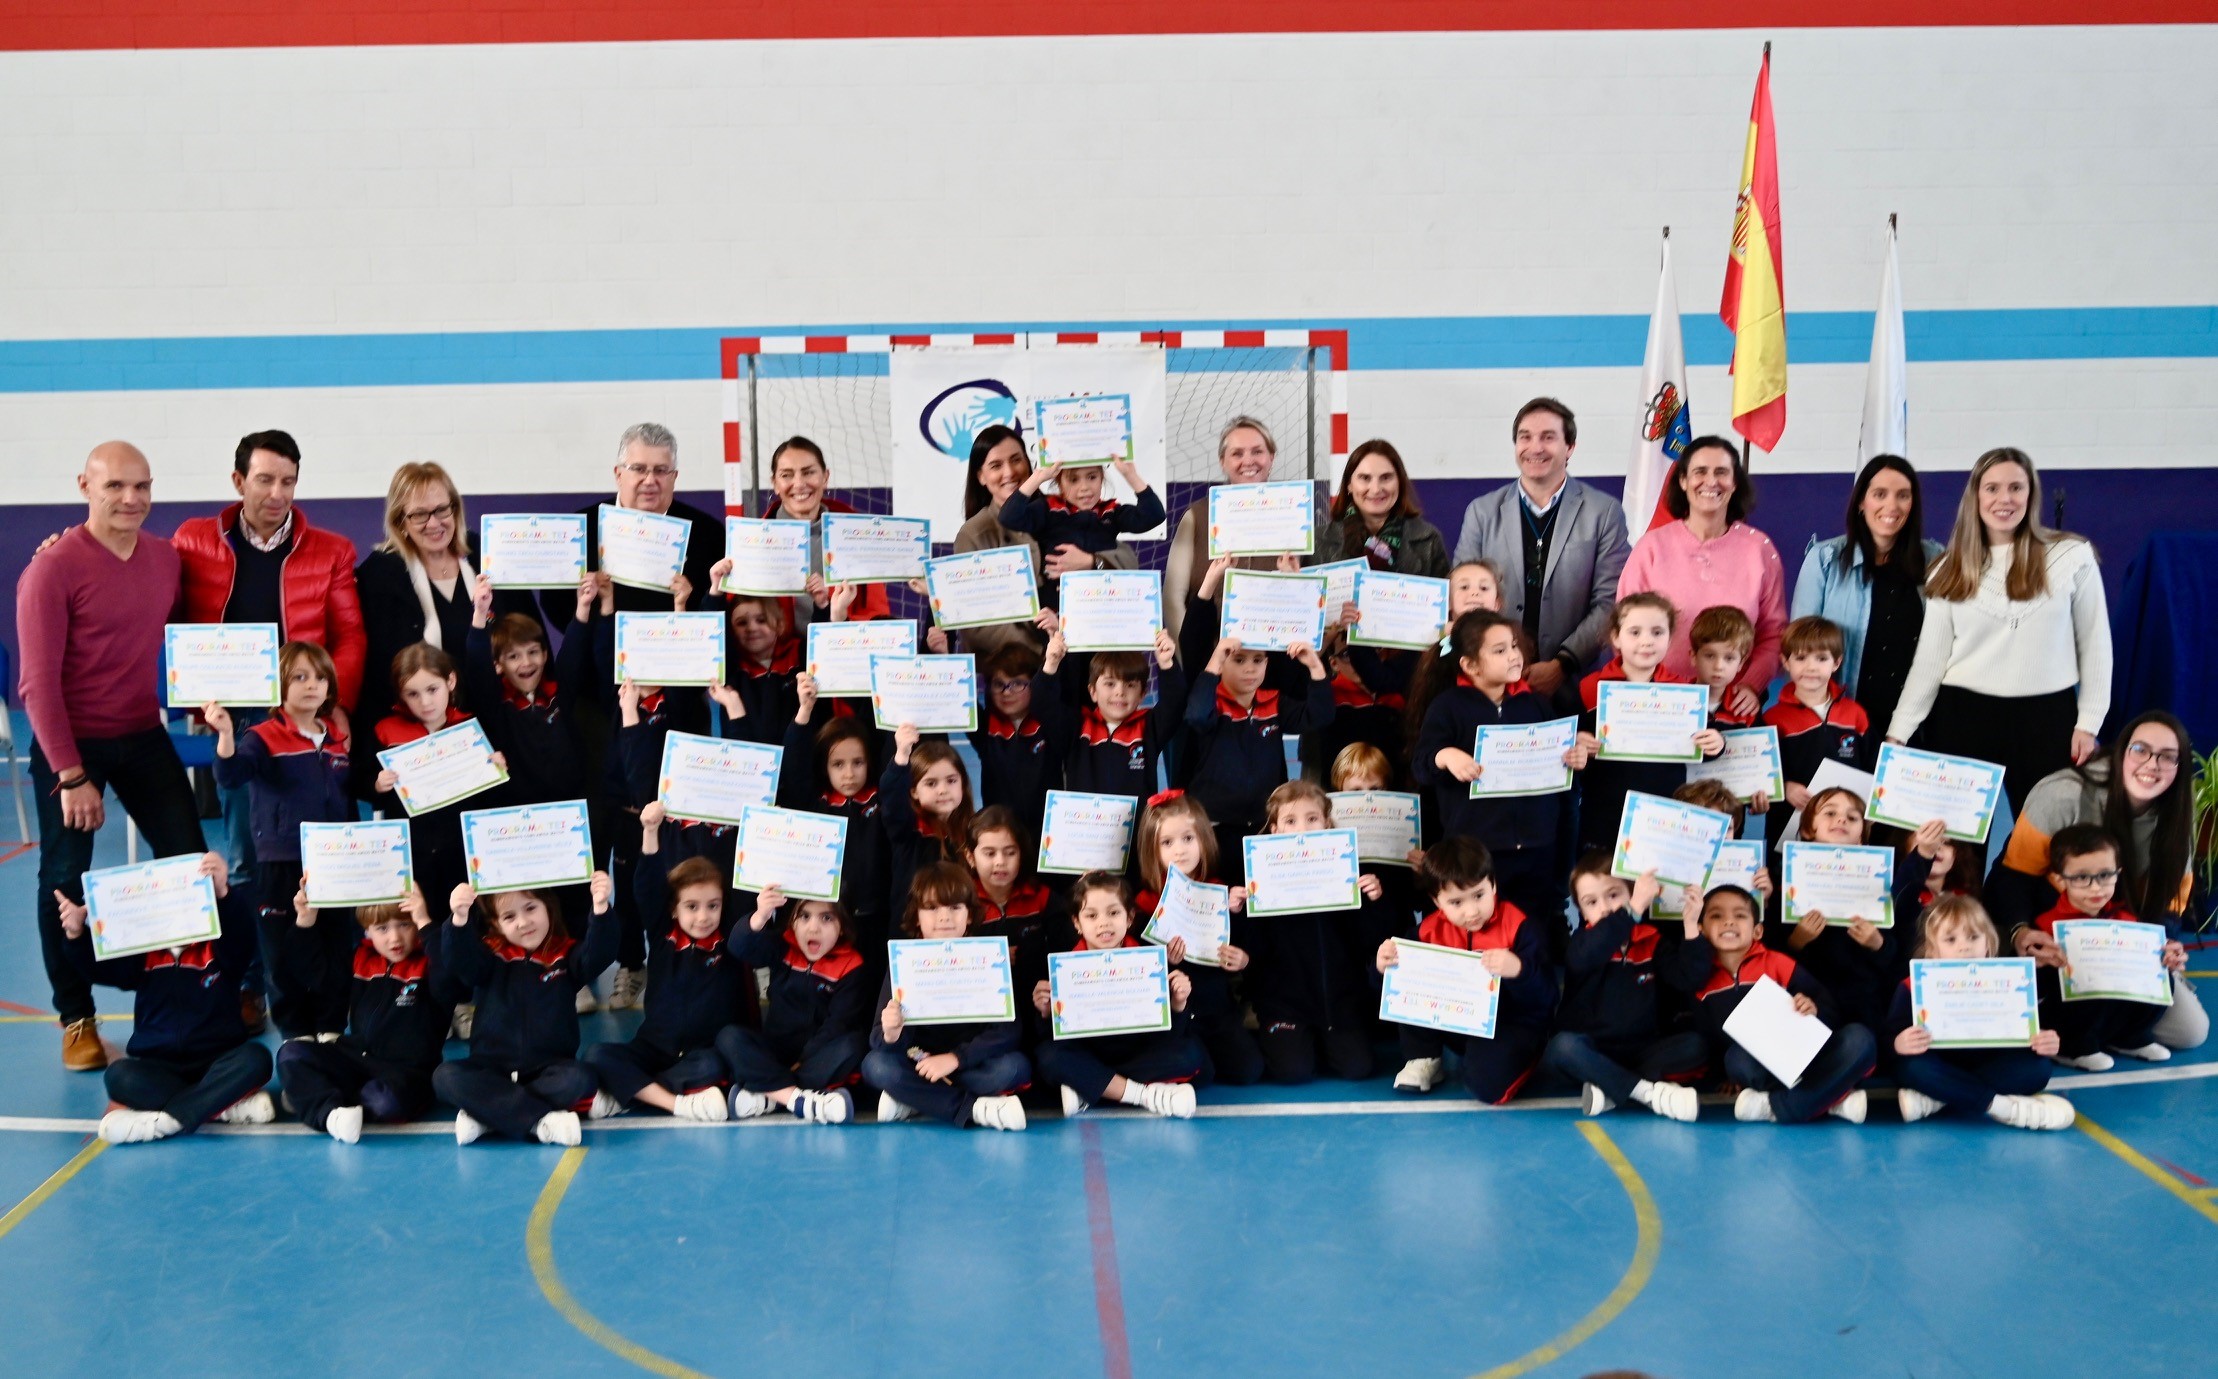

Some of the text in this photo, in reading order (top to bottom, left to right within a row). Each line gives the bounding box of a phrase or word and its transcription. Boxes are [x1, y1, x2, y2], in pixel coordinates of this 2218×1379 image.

[1053, 411, 1096, 421] PROGRAMA
[1228, 498, 1276, 508] PROGRAMA
[500, 530, 548, 539] PROGRAMA
[611, 524, 653, 537] PROGRAMA
[842, 528, 890, 537] PROGRAMA
[738, 536, 779, 544] PROGRAMA
[946, 566, 993, 580] PROGRAMA
[1074, 587, 1122, 596] PROGRAMA
[1371, 589, 1416, 599] PROGRAMA
[636, 629, 684, 637] PROGRAMA
[1262, 624, 1307, 634] PROGRAMA
[186, 643, 235, 651] PROGRAMA
[828, 637, 875, 647] PROGRAMA
[886, 671, 934, 680] PROGRAMA
[1620, 700, 1667, 709] PROGRAMA
[1496, 740, 1544, 749] PROGRAMA
[685, 754, 738, 767] PROGRAMA
[1901, 768, 1954, 784] PROGRAMA
[1064, 811, 1109, 821] PROGRAMA
[1336, 807, 1384, 816] PROGRAMA
[488, 823, 543, 836] PROGRAMA
[1647, 816, 1694, 833] PROGRAMA
[756, 824, 802, 840] PROGRAMA
[314, 840, 365, 851] PROGRAMA
[1265, 850, 1316, 861] PROGRAMA
[1805, 861, 1853, 872] PROGRAMA
[110, 879, 166, 896] PROGRAMA
[911, 956, 966, 968] PROGRAMA
[1071, 967, 1124, 979] PROGRAMA
[1936, 979, 1989, 988] PROGRAMA
[1424, 999, 1474, 1015] PROGRAMA
